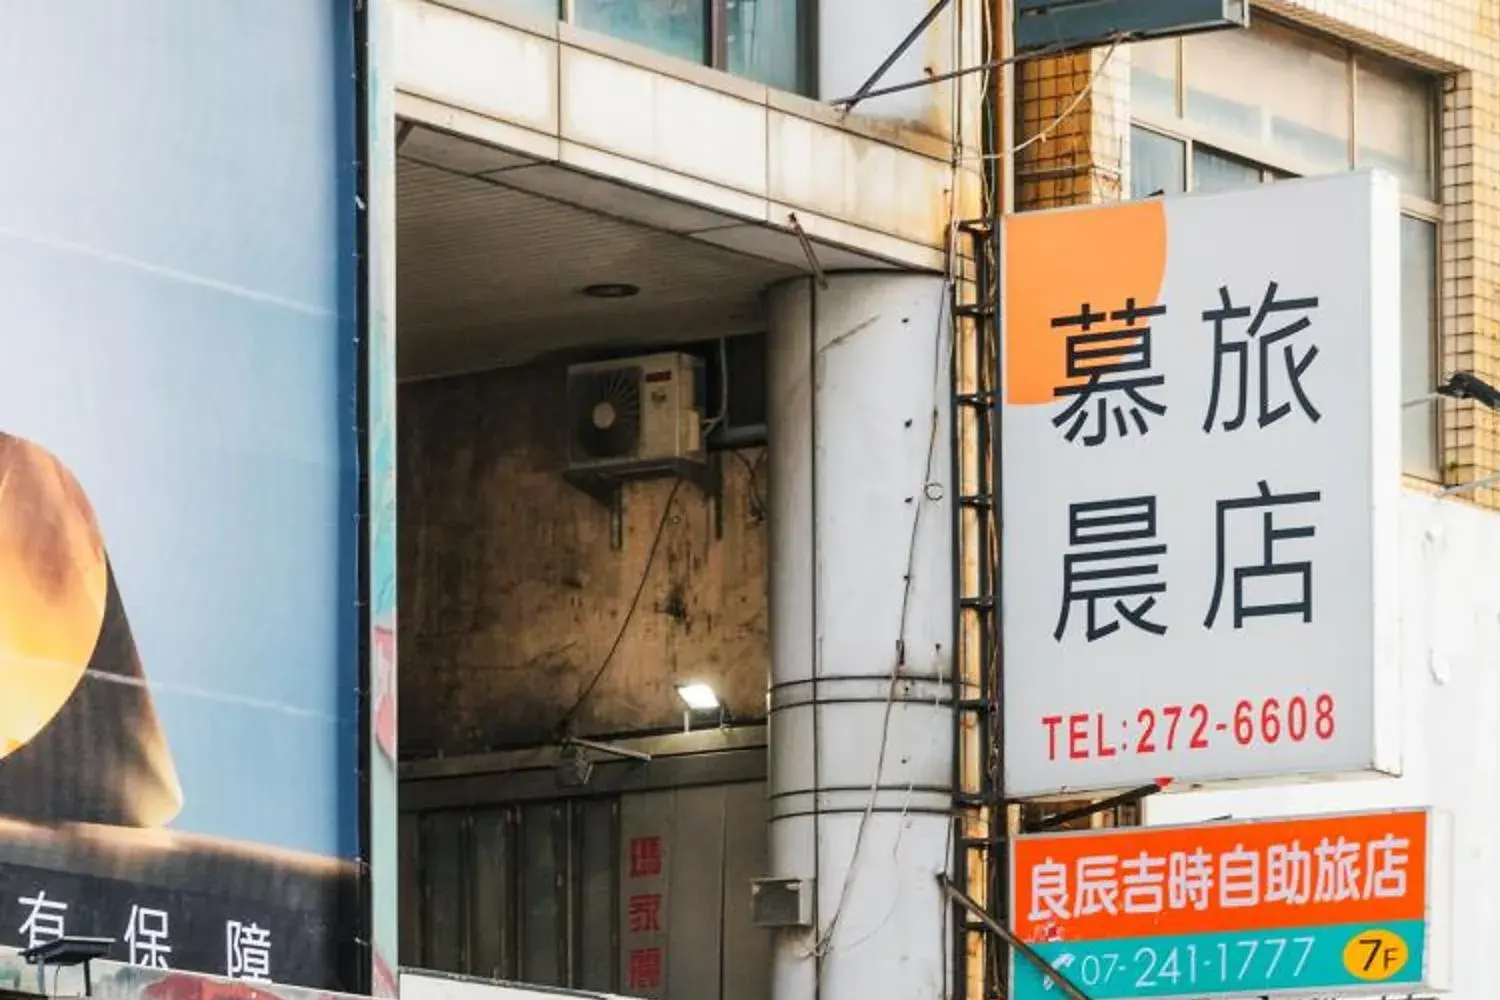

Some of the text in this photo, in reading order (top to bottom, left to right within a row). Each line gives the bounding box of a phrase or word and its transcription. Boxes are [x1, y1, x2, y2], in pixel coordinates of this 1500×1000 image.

[1051, 297, 1167, 642] 慕晨
[1202, 281, 1321, 630] 旅店
[1027, 833, 1409, 923] 良辰吉時自助旅店
[18, 890, 272, 984] 有保障
[1080, 936, 1316, 988] 07-241-1777
[1358, 938, 1398, 973] 7F
